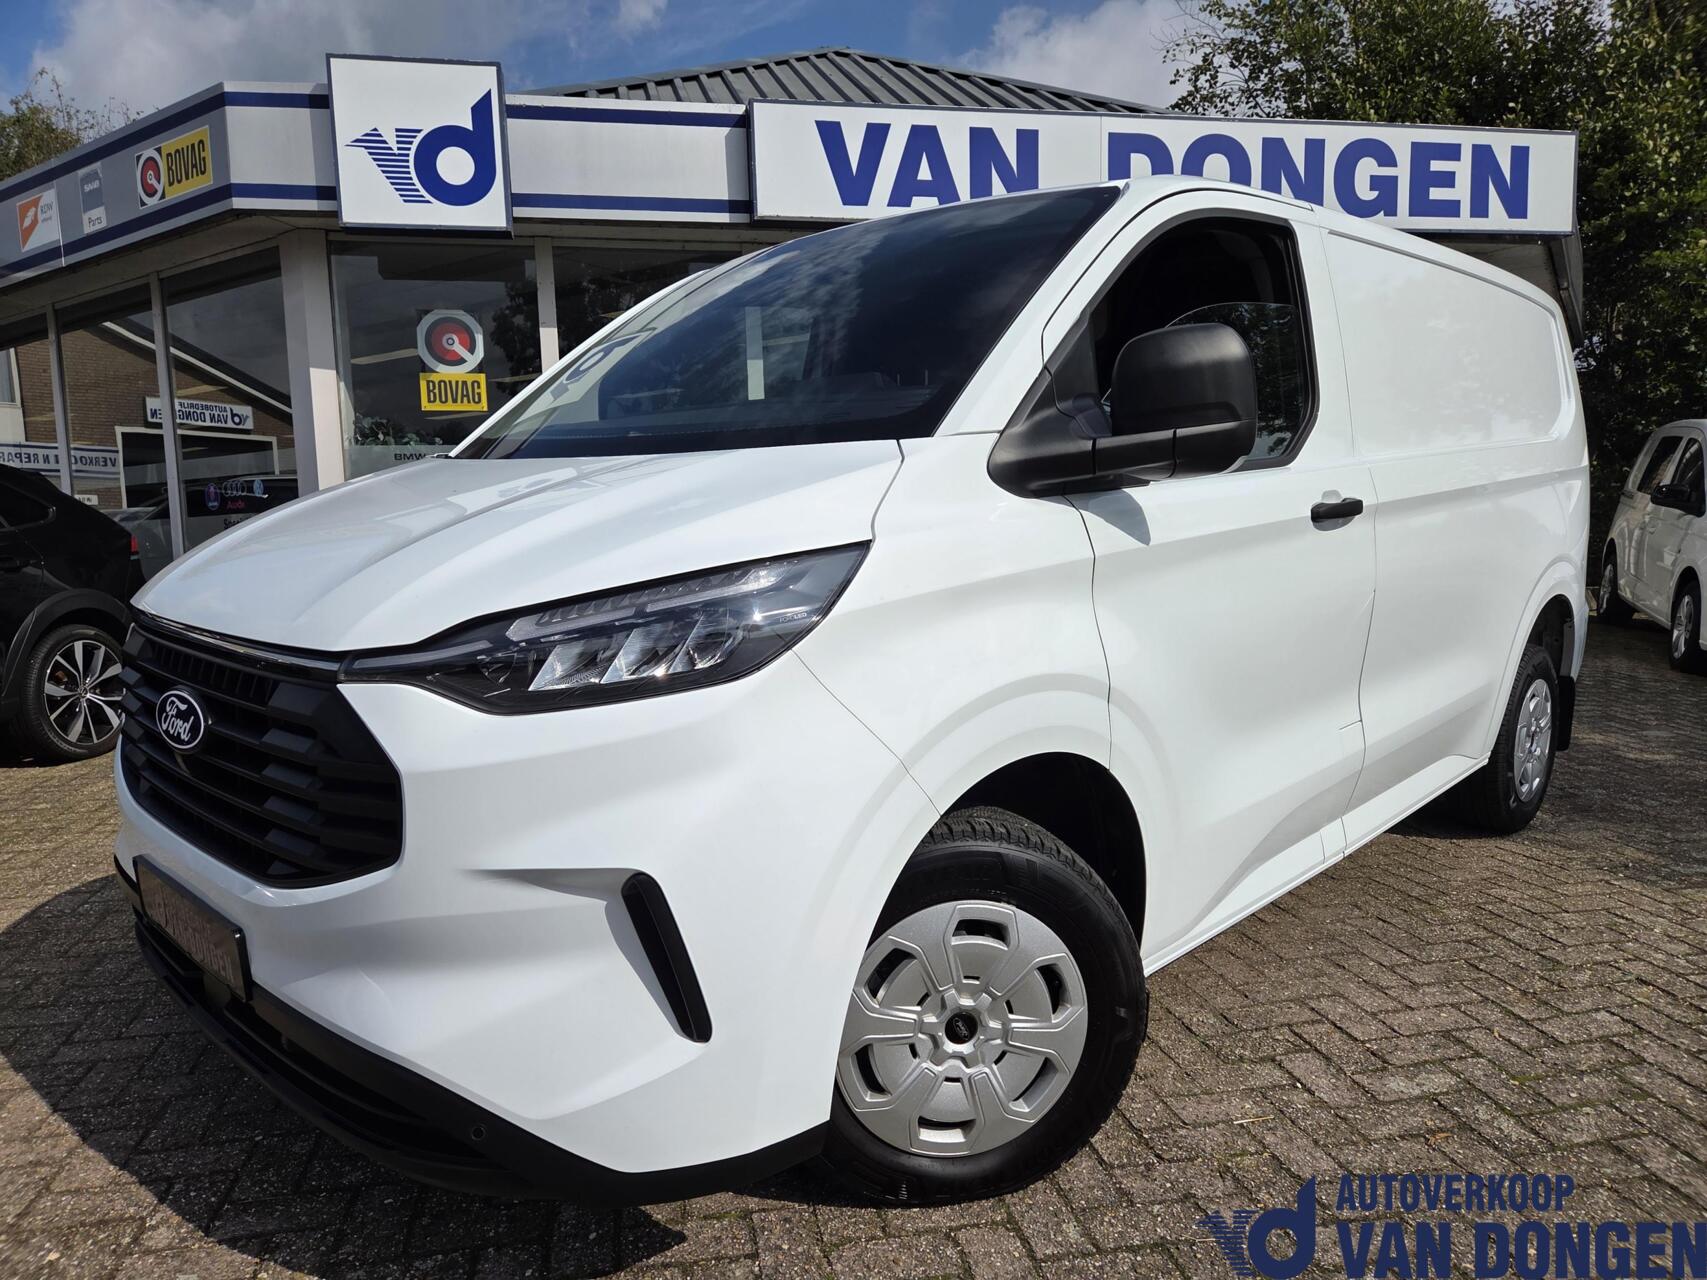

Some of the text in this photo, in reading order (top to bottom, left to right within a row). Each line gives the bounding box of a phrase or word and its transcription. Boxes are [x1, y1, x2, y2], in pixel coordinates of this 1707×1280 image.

[166, 139, 206, 187] BOVAG
[816, 121, 1530, 220] VAN DONGEN
[88, 217, 103, 228] Parts
[426, 379, 482, 404] BOVAG
[394, 453, 426, 461] BMW
[161, 696, 194, 741] Ford
